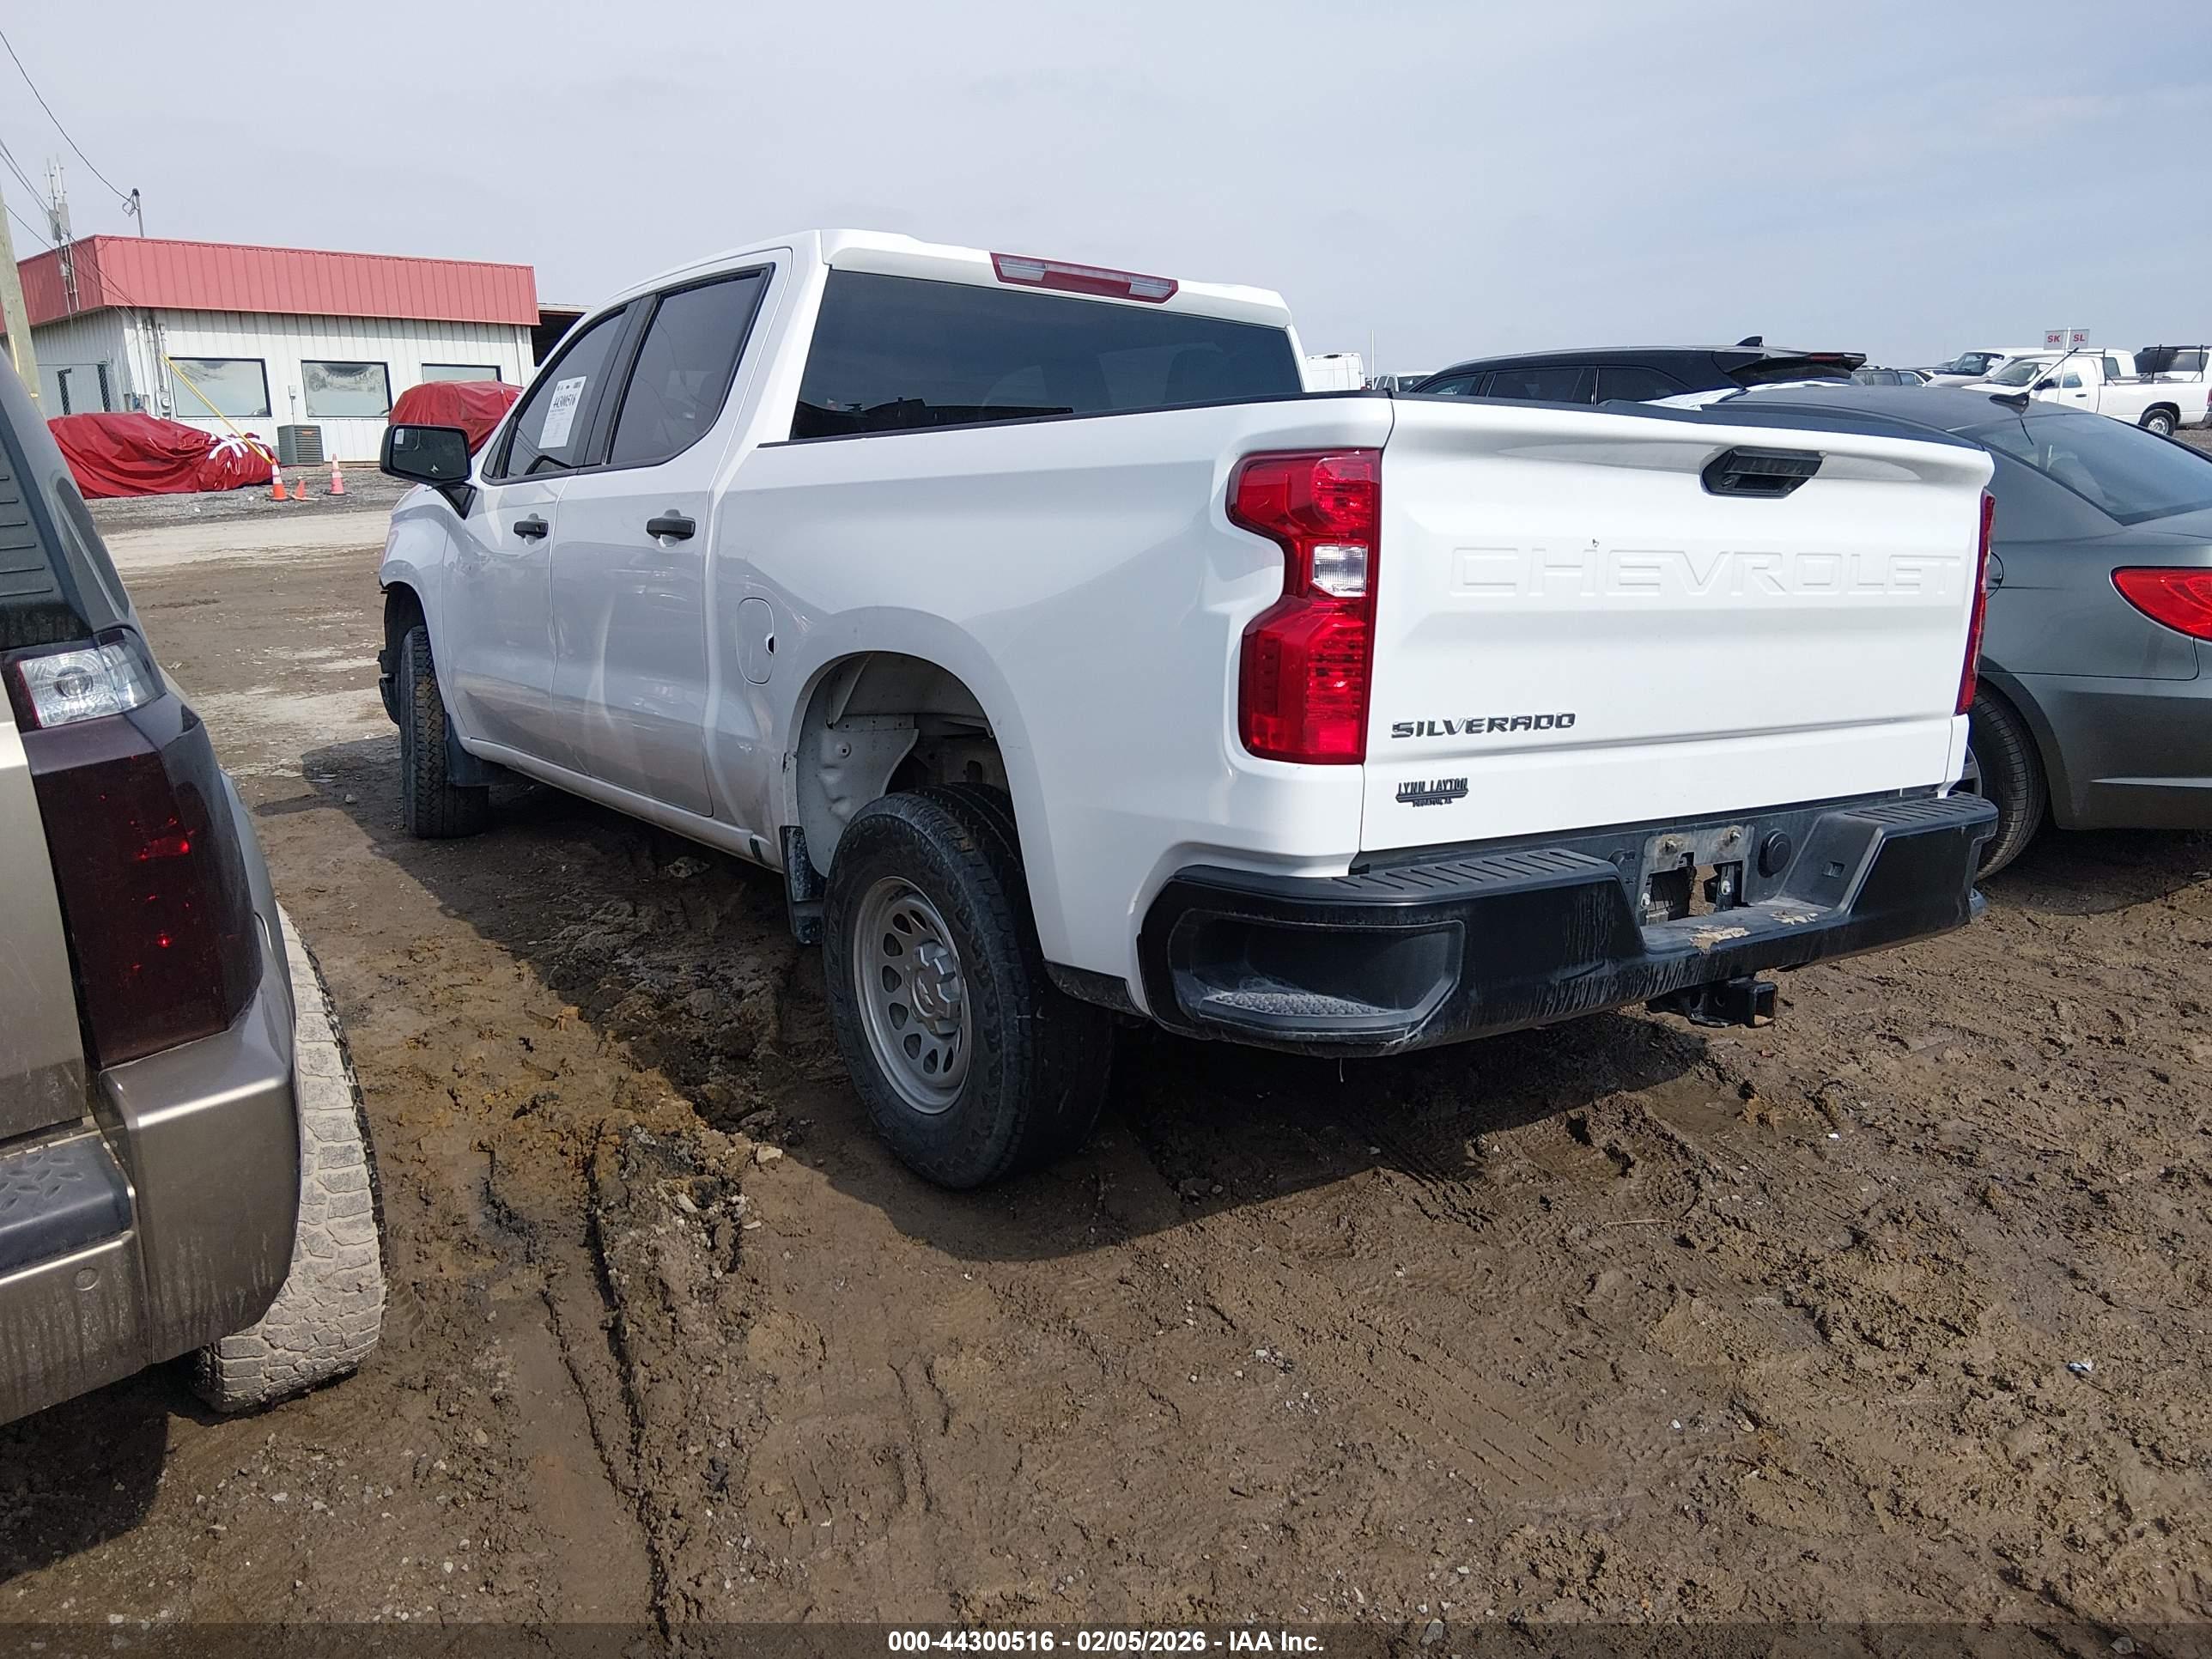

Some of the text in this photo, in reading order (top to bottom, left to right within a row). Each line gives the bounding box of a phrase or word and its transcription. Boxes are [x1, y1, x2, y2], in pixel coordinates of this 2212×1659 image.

[2074, 333, 2086, 342] SL
[1449, 547, 1960, 597] CHEVROLET
[1391, 712, 1576, 738] SILVERADO
[1397, 777, 1468, 794] LYNN LAYTON
